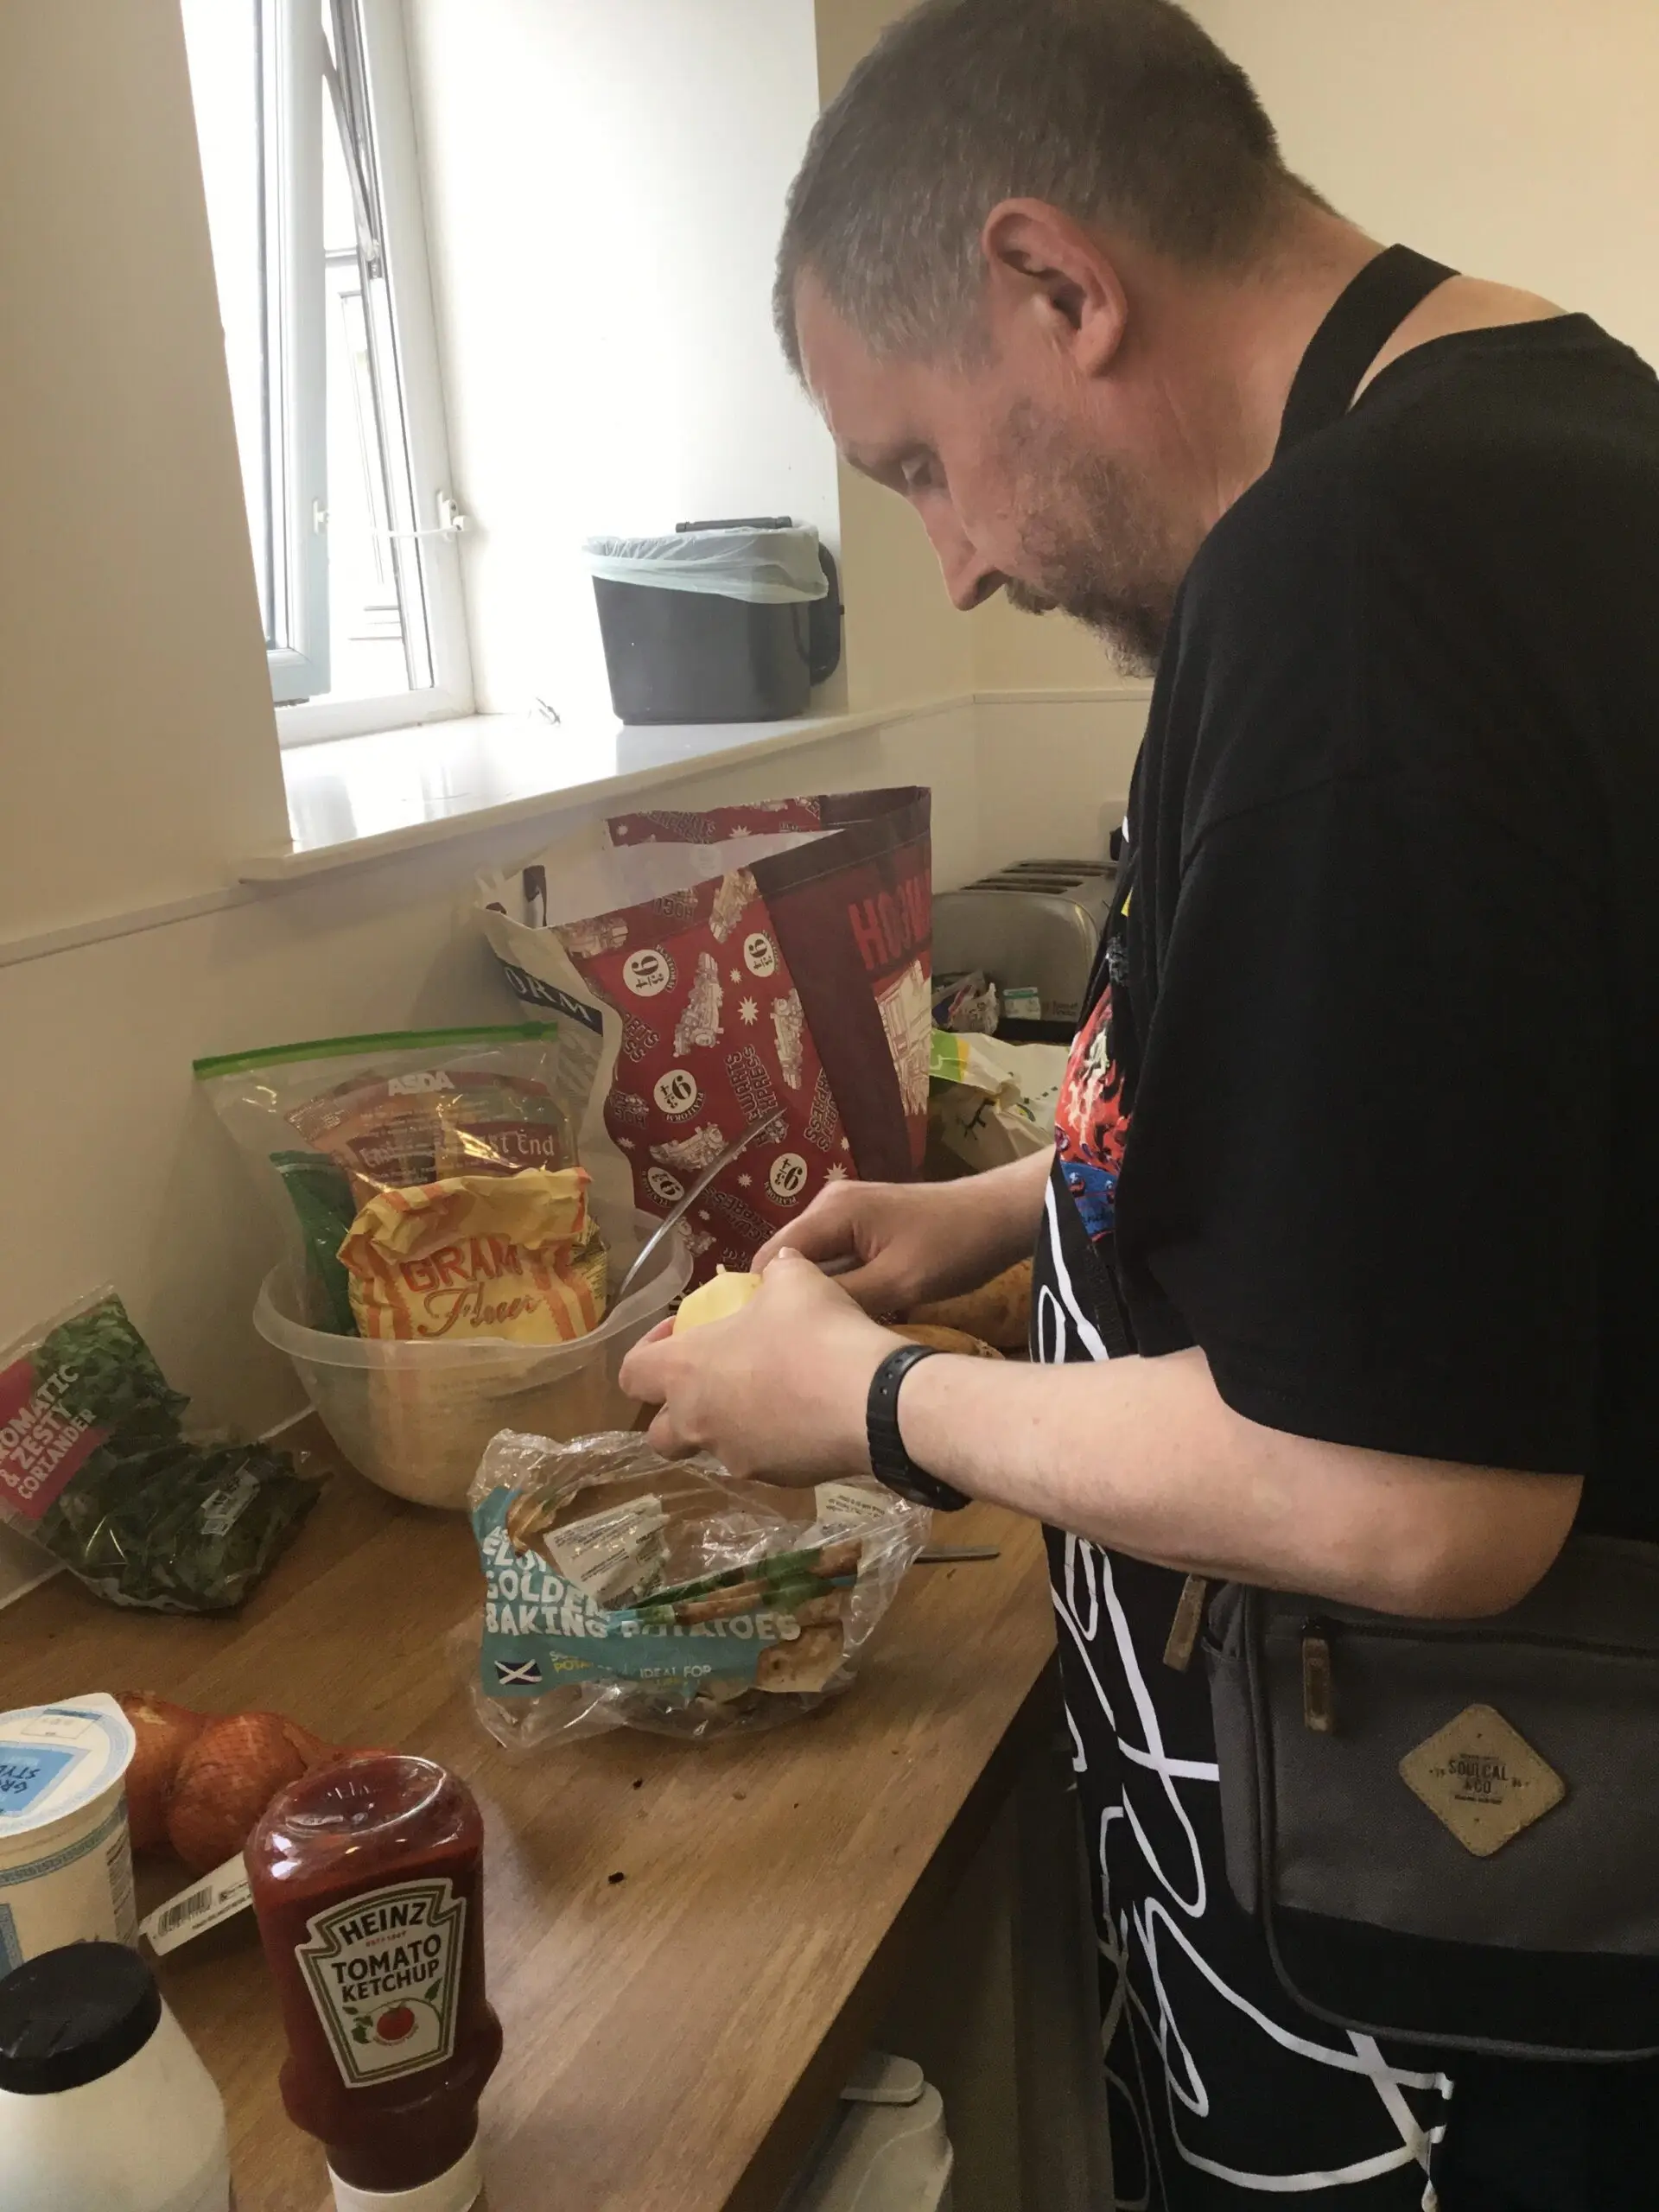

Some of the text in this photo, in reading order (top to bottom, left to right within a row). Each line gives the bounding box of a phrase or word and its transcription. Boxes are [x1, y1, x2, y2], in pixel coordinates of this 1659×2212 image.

[388, 1071, 454, 1096] ASDA
[724, 1051, 768, 1147] HGWARTS
[743, 1043, 779, 1118] XPRESS
[518, 1132, 555, 1156] End
[400, 1236, 524, 1293] GRAM
[10, 1398, 72, 1470] ZESTY
[17, 1408, 97, 1499] CORIANDER
[486, 1603, 608, 1638] BAKING
[1448, 1759, 1509, 1781] SOULCAL
[339, 1902, 427, 1945] HEINZ
[331, 1934, 442, 1984] TOMATO
[341, 1958, 440, 2003] KETCHUP
